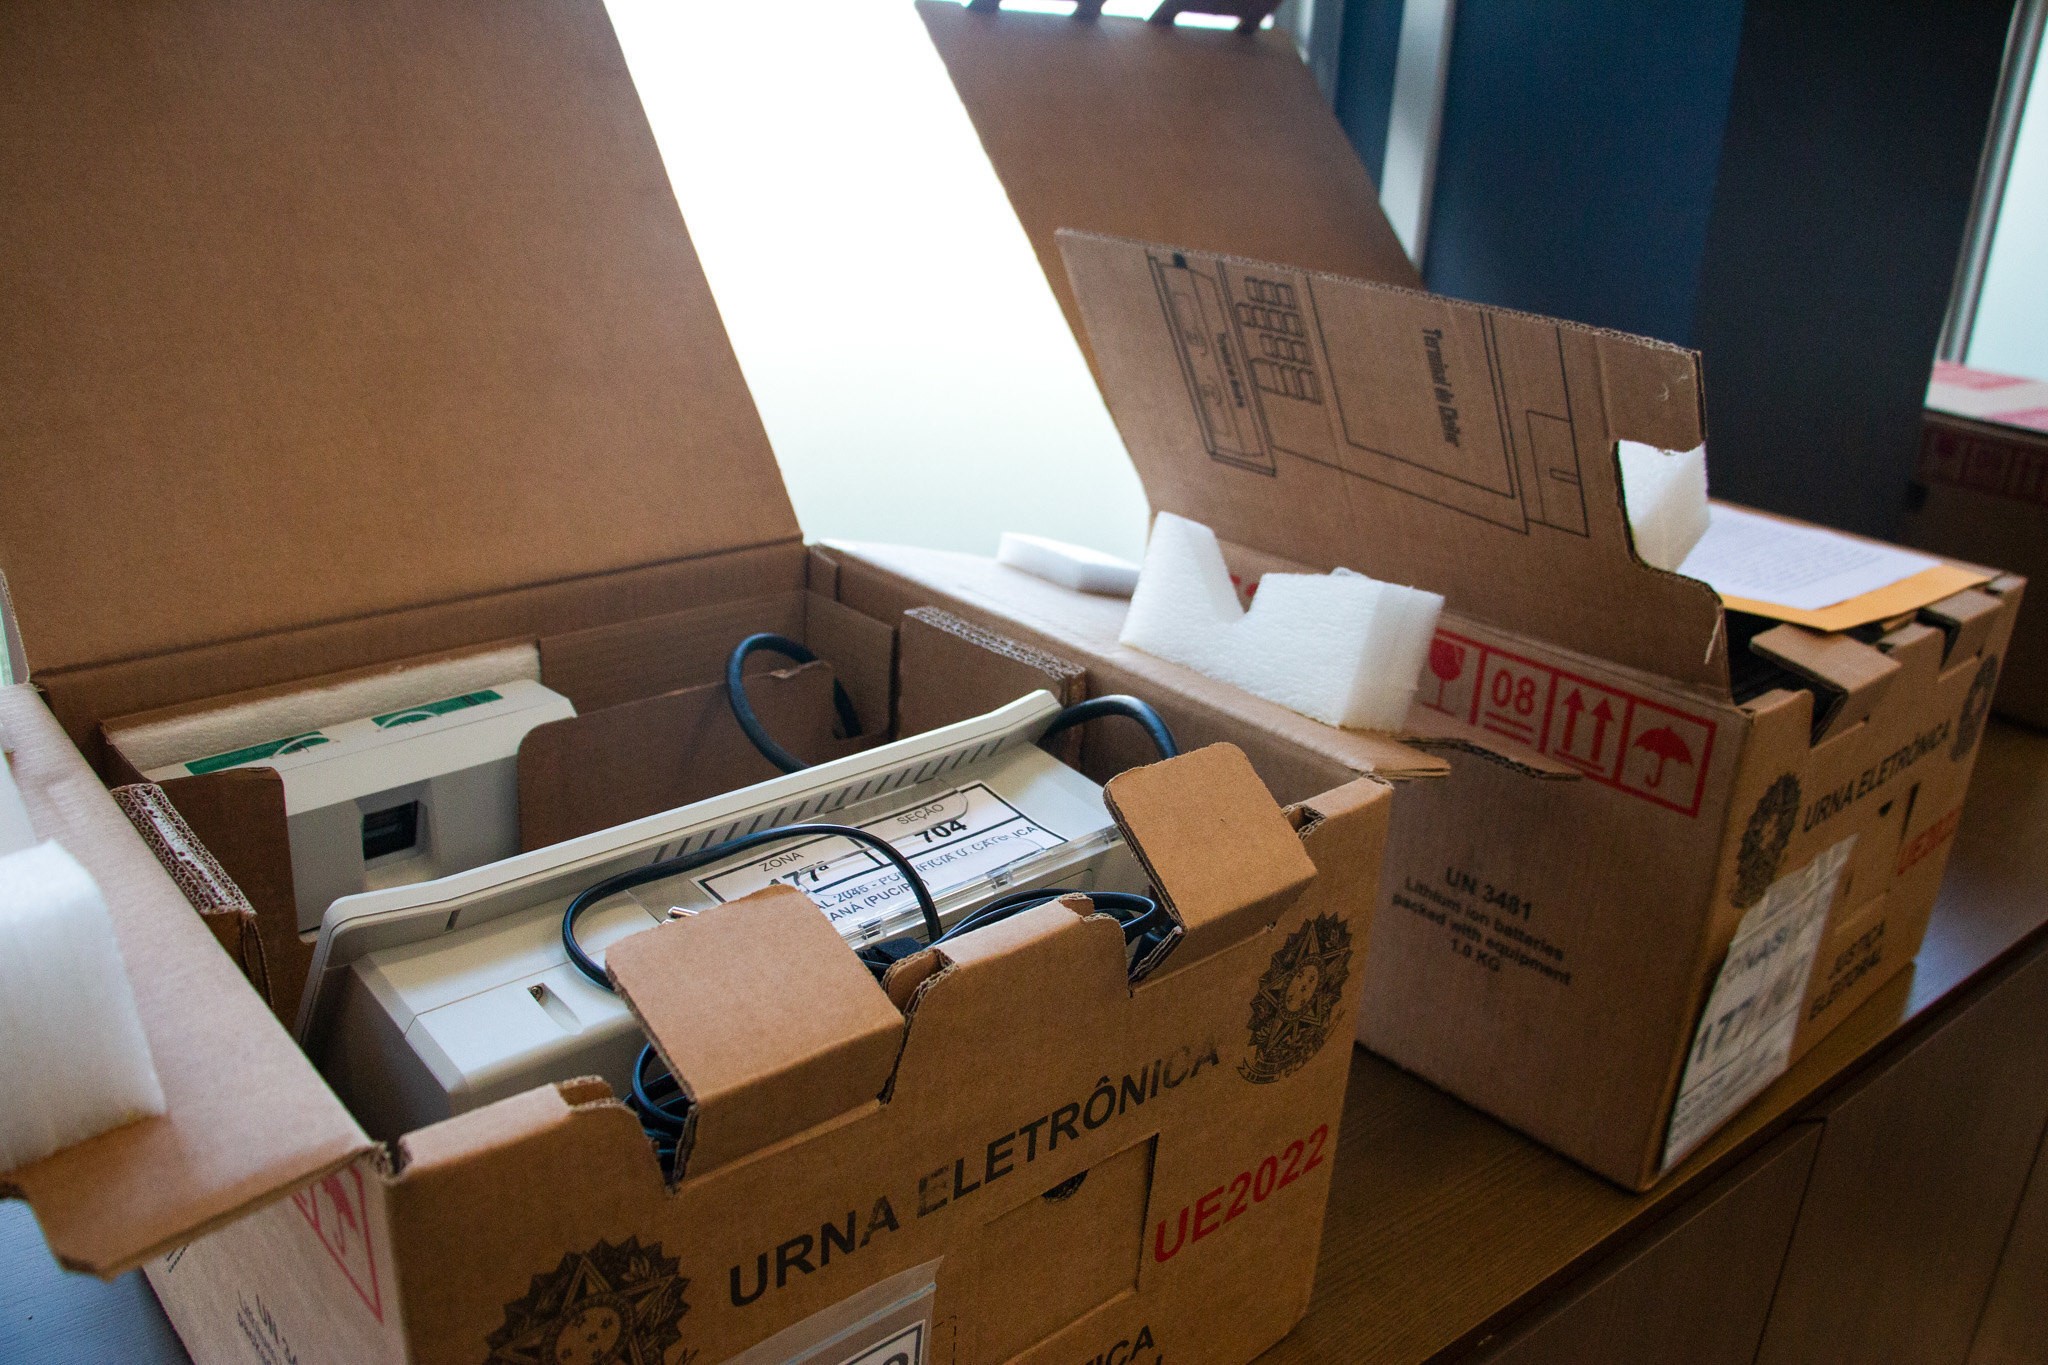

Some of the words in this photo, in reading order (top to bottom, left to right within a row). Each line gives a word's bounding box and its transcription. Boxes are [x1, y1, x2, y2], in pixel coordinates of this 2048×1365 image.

[1491, 668, 1536, 717] 08
[896, 803, 944, 825] SEÇÃO
[915, 819, 967, 843] 704
[759, 852, 804, 873] ZONA
[864, 877, 929, 907] (PUC/P)
[1446, 867, 1479, 896] UN
[1483, 883, 1532, 921] 3481
[1404, 875, 1462, 914] Lithium
[1464, 903, 1490, 927] ion
[1493, 918, 1564, 962] batteries
[1475, 948, 1502, 974] KG
[1484, 931, 1573, 986] equipment
[729, 1194, 900, 1307] URNA
[916, 1036, 1220, 1218] ELETRÔNICA
[1154, 1123, 1329, 1263] UE2022
